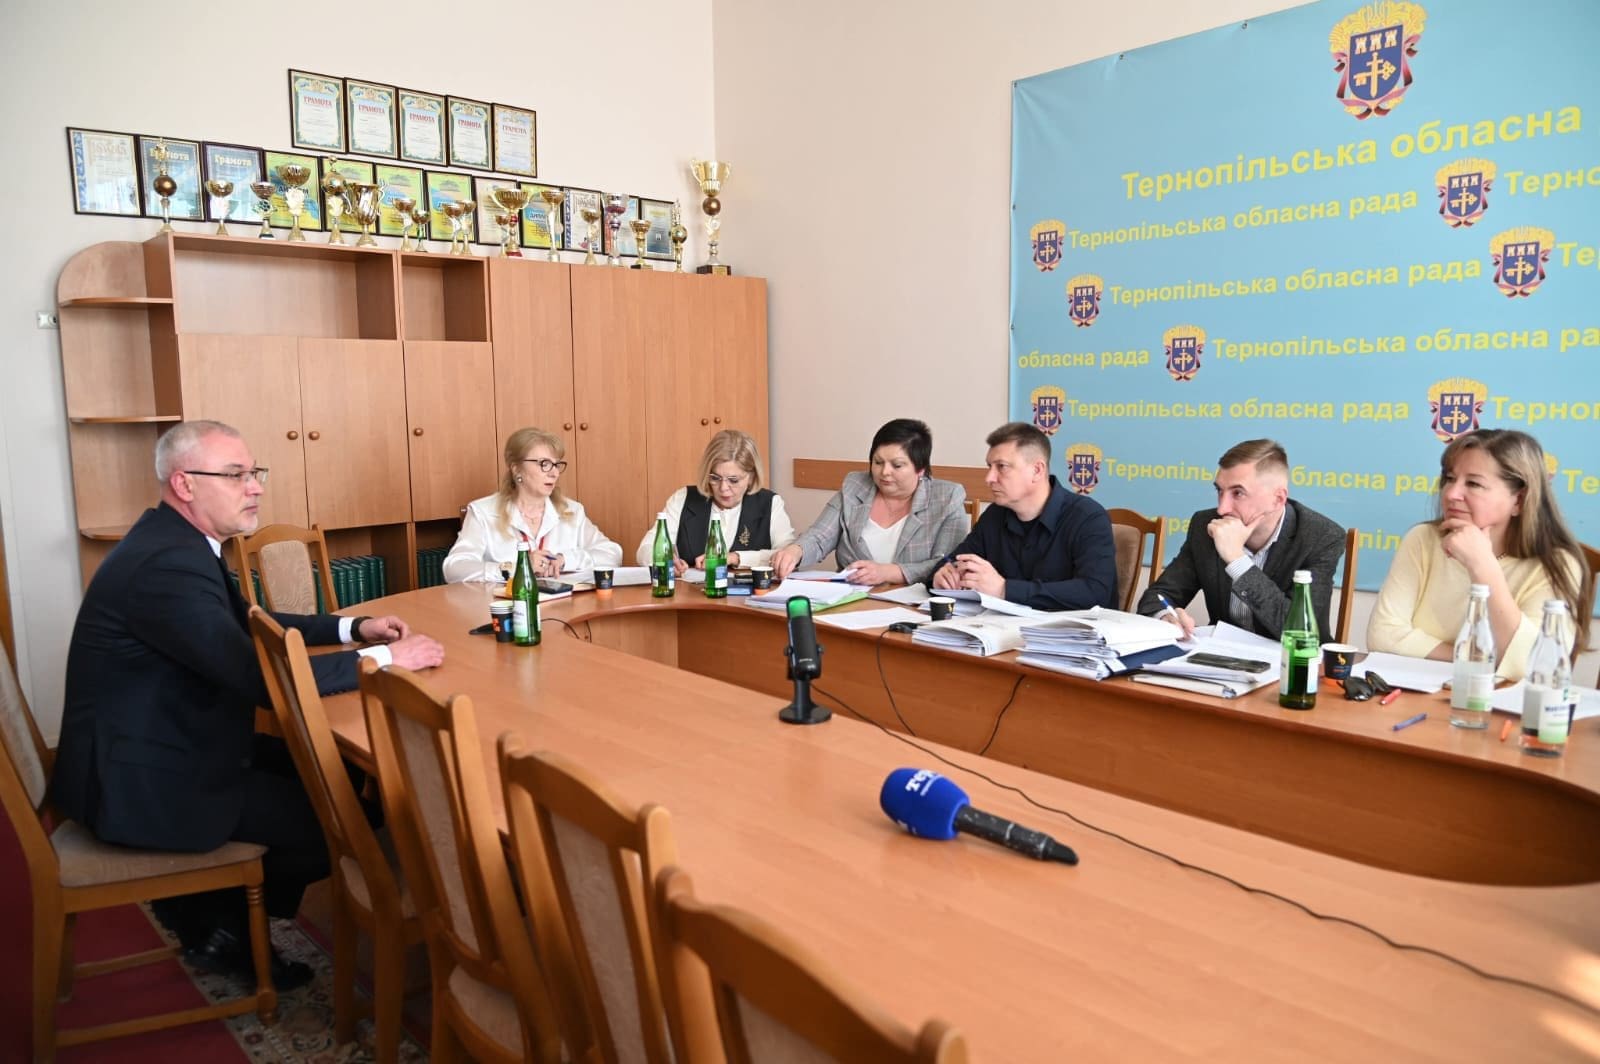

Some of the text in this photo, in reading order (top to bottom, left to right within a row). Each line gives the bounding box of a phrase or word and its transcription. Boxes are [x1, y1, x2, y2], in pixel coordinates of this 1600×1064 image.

[304, 96, 332, 107] ГРАМОТА
[1121, 105, 1582, 202] Тернопільська обласна
[1068, 190, 1418, 250] Тернопільська обласна рада
[1109, 258, 1482, 307] Тернопільська обласна рада
[1018, 350, 1150, 370] обласна рада
[1212, 335, 1407, 363] Тернопільська
[1415, 326, 1550, 353] обласна
[1068, 396, 1410, 424] Тернопільська обласна рада
[1104, 457, 1215, 482] Тернопіль
[1290, 465, 1387, 490] бласна
